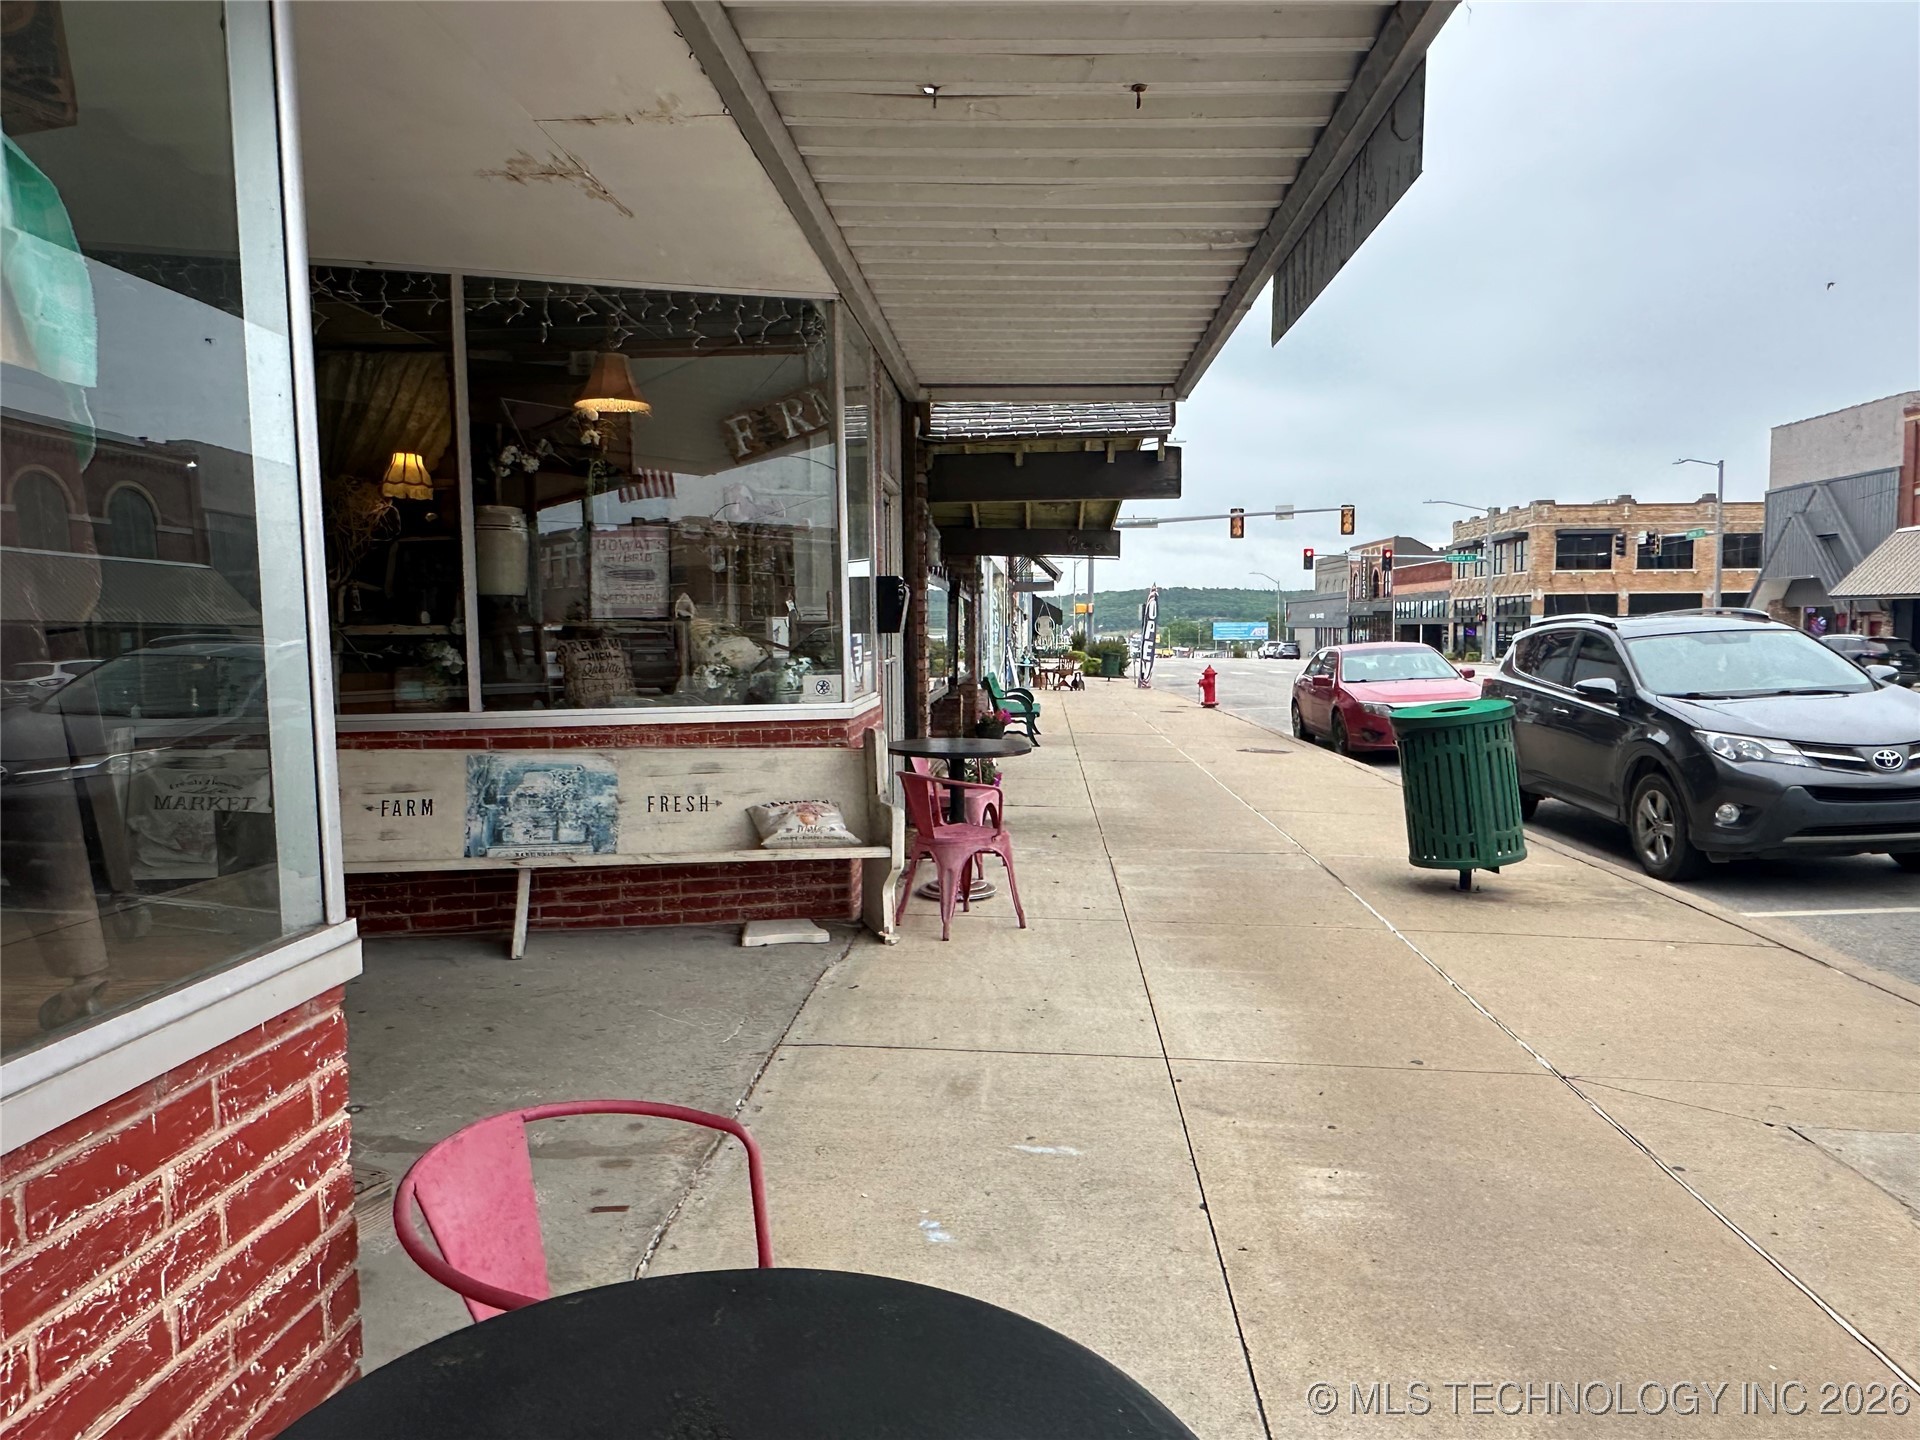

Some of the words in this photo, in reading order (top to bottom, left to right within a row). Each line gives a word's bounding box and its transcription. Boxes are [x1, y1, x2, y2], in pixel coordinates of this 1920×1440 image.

[1142, 600, 1157, 680] OPEN
[154, 795, 257, 811] MARKET
[381, 798, 433, 817] FARM
[647, 795, 709, 813] FRESH
